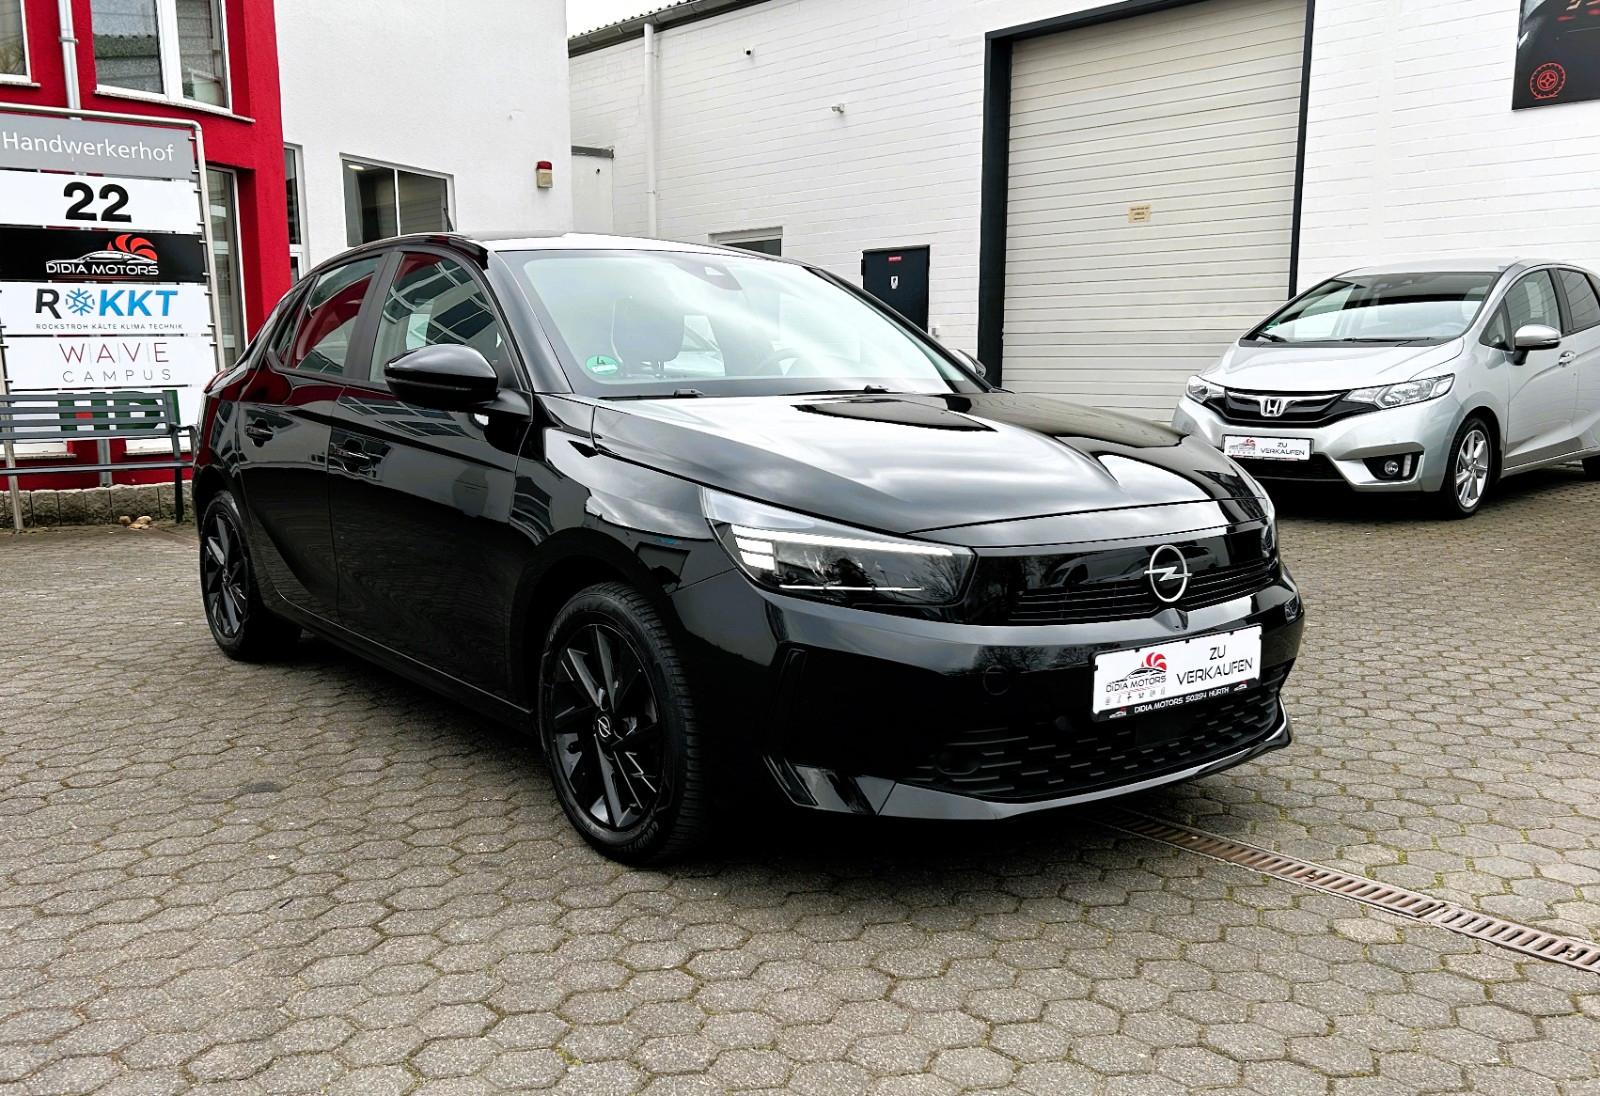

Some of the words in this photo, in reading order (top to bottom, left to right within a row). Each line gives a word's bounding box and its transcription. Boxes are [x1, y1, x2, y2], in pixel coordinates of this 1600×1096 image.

[2, 131, 174, 161] Handwerkerhof
[64, 181, 132, 223] 22
[46, 262, 86, 275] DIDIA
[91, 263, 160, 276] MOTORS
[92, 322, 117, 330] KÄLTE
[62, 368, 172, 383] CAMPUS
[1260, 447, 1306, 456] VERKAUFEN
[1209, 645, 1227, 661] ZU
[1176, 658, 1253, 686] VERKAUFEN
[1105, 681, 1129, 693] DIDIA
[1130, 675, 1167, 689] MOTORS
[1134, 703, 1154, 714] DIDIA
[1154, 696, 1183, 709] MOTORS
